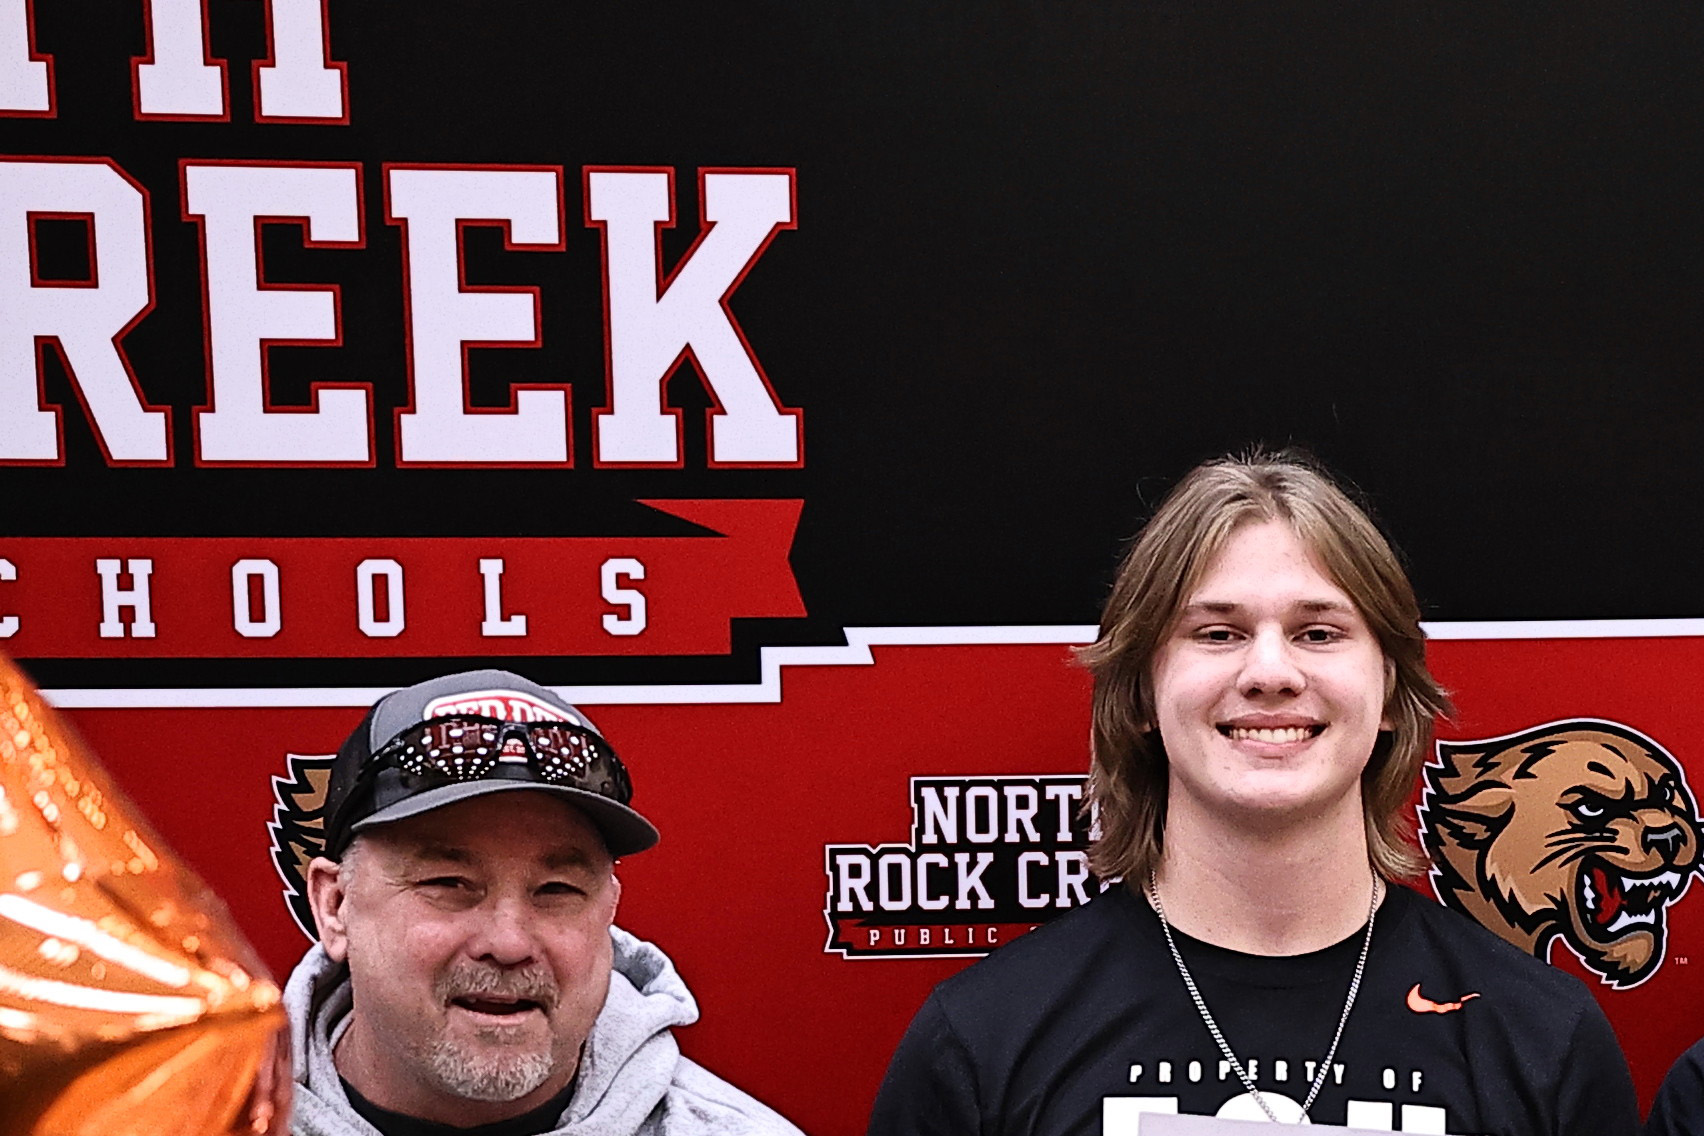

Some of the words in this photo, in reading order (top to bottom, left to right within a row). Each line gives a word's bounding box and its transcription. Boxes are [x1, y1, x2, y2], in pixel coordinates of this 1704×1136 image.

[835, 853, 995, 912] ROCK
[869, 927, 998, 946] PUBLIC
[1129, 1059, 1346, 1084] PROPERTY
[1382, 1068, 1424, 1092] OF
